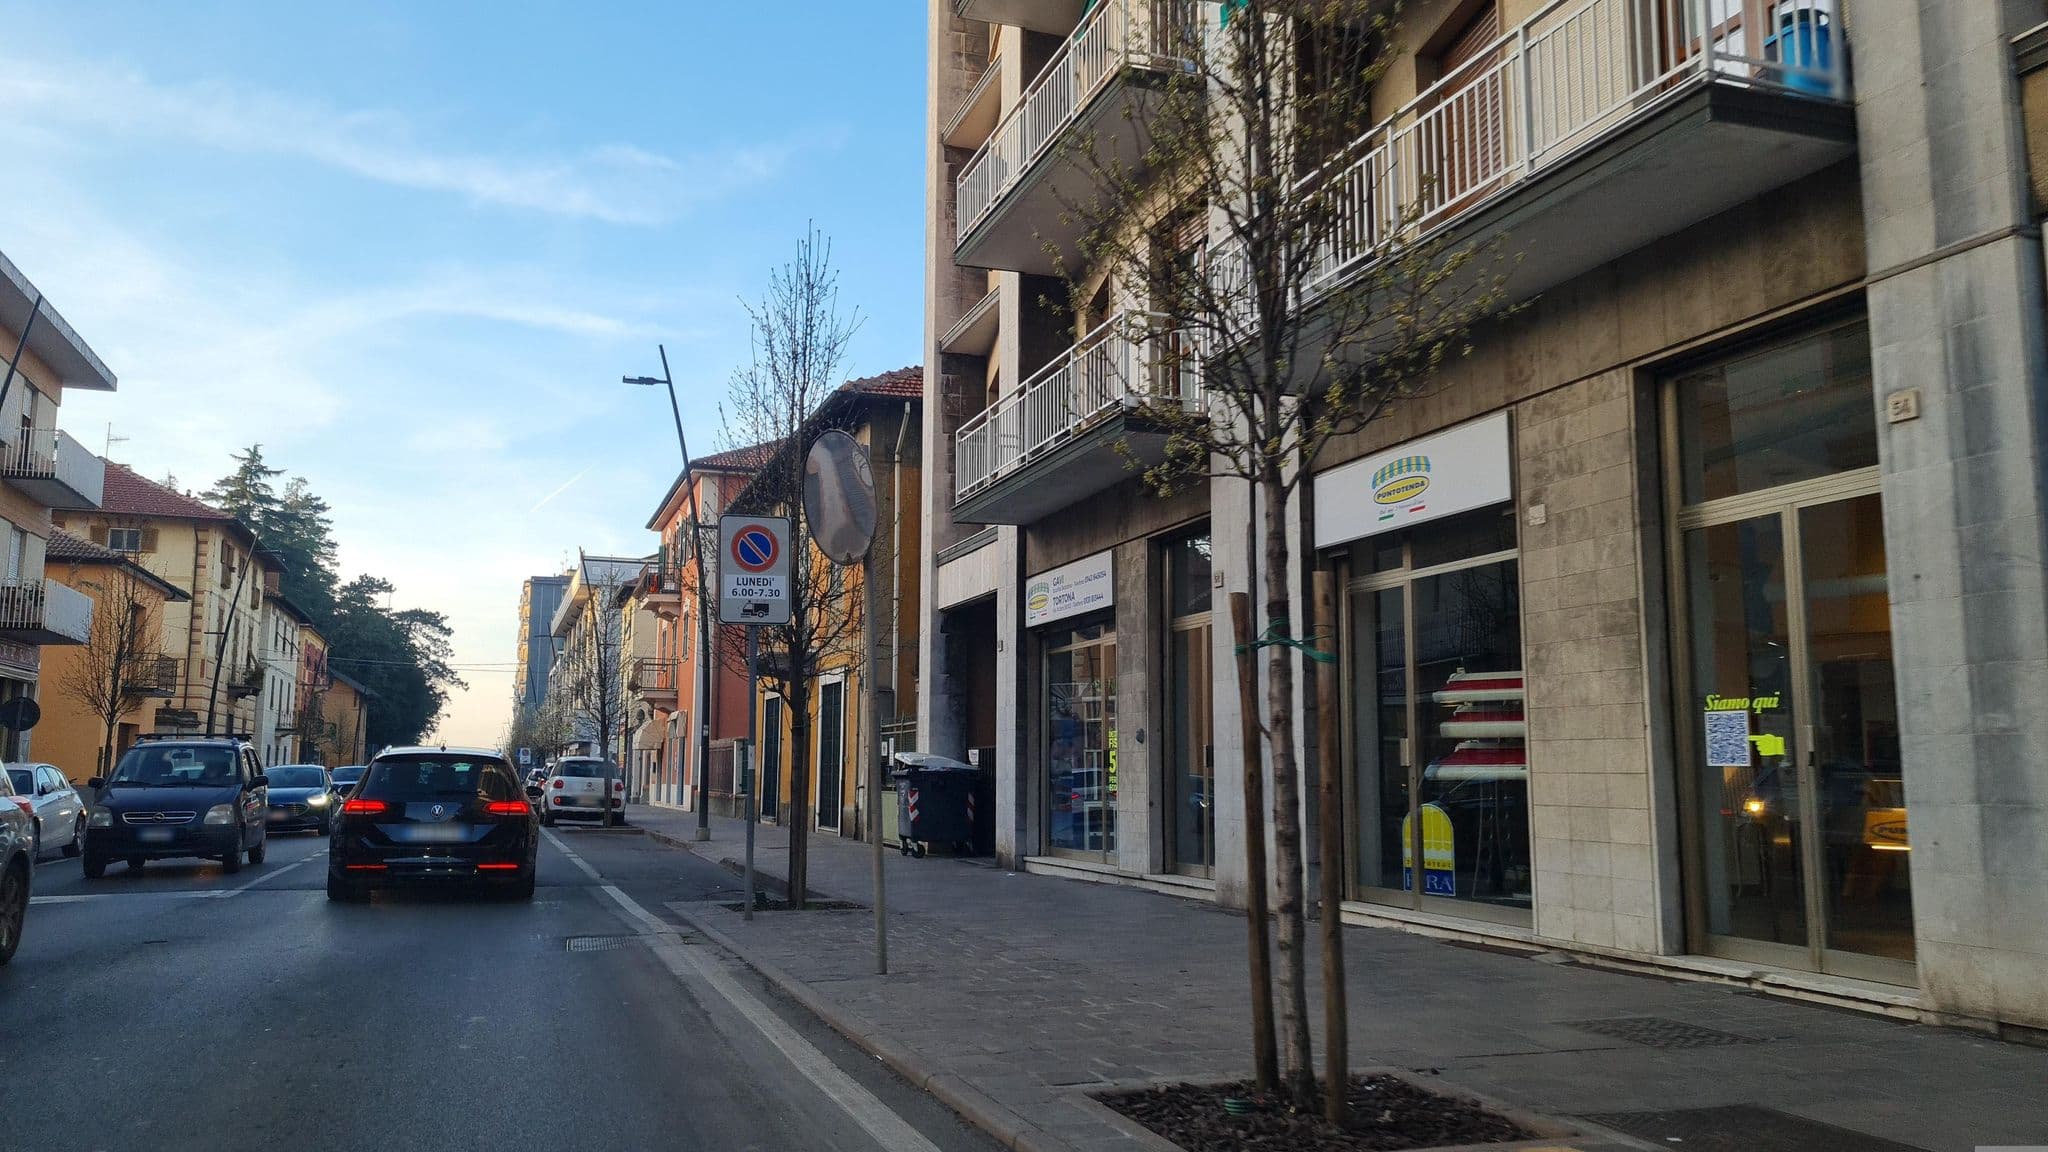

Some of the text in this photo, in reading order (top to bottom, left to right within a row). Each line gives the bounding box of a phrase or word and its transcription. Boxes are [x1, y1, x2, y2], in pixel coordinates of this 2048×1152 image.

[1377, 481, 1425, 500] PUNTOTENDA
[731, 588, 780, 598] 6.00-7.30
[1704, 691, 1780, 713] Siamo qui
